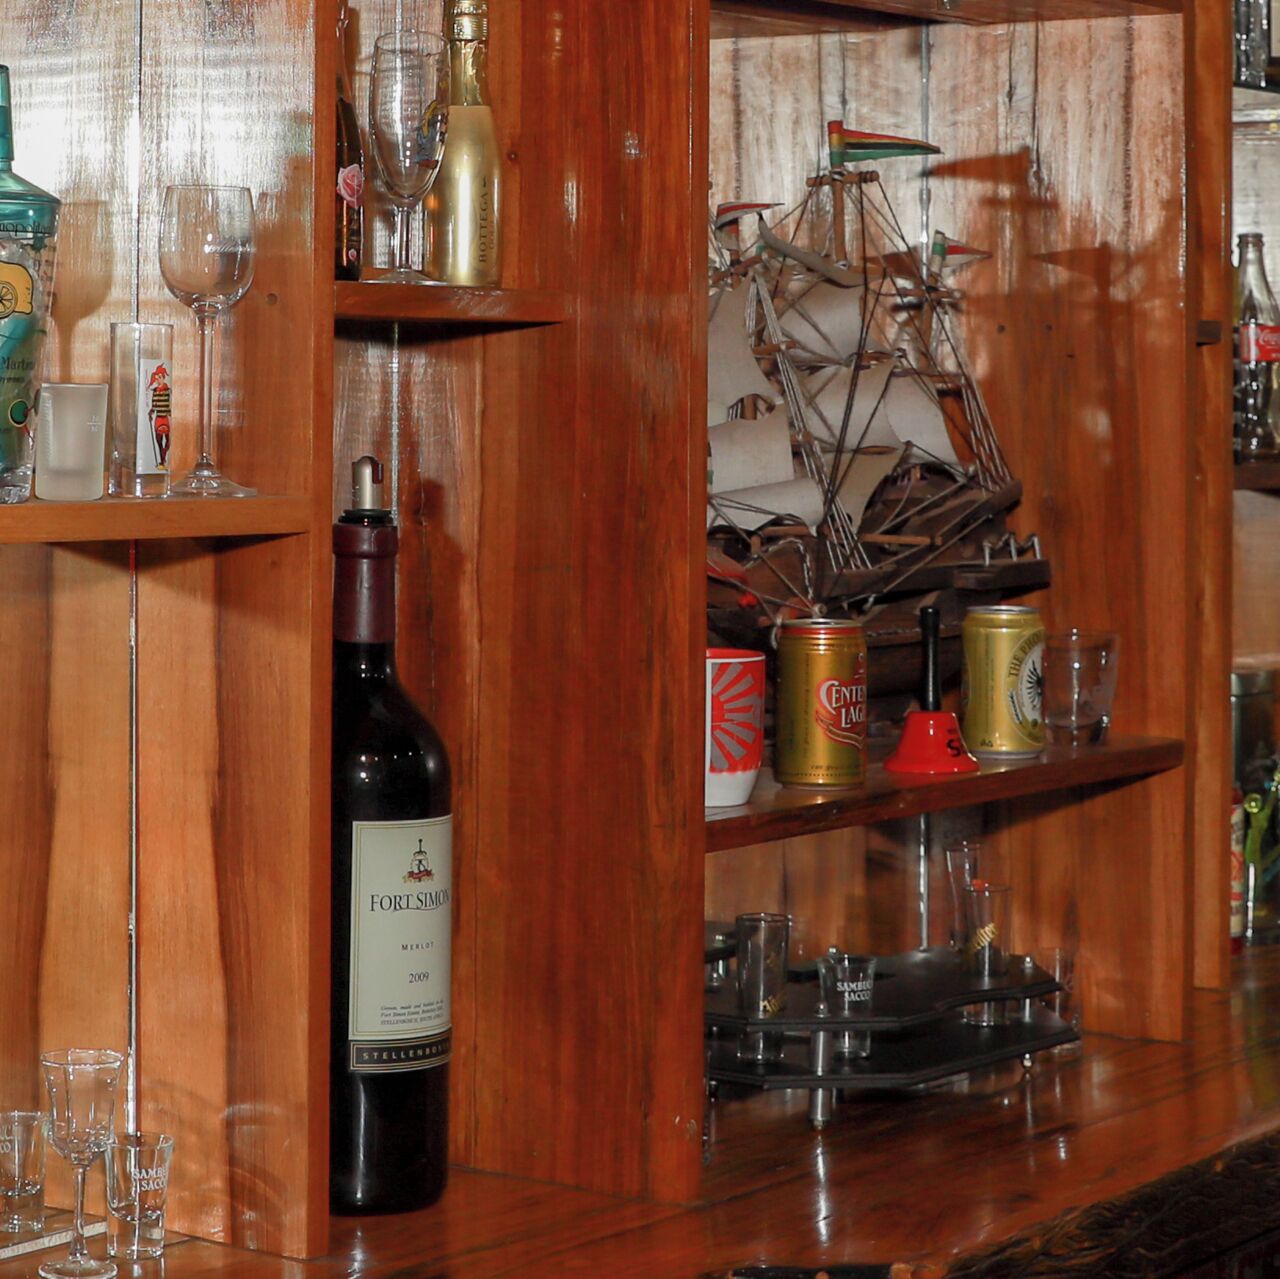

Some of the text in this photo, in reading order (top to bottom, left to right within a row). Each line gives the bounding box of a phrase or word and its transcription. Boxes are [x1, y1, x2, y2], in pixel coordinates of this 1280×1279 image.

[479, 192, 488, 263] BOTTEGA
[1008, 652, 1023, 679] THE
[370, 892, 412, 913] FORT
[401, 941, 435, 952] MERLOT
[408, 972, 430, 984] 2009
